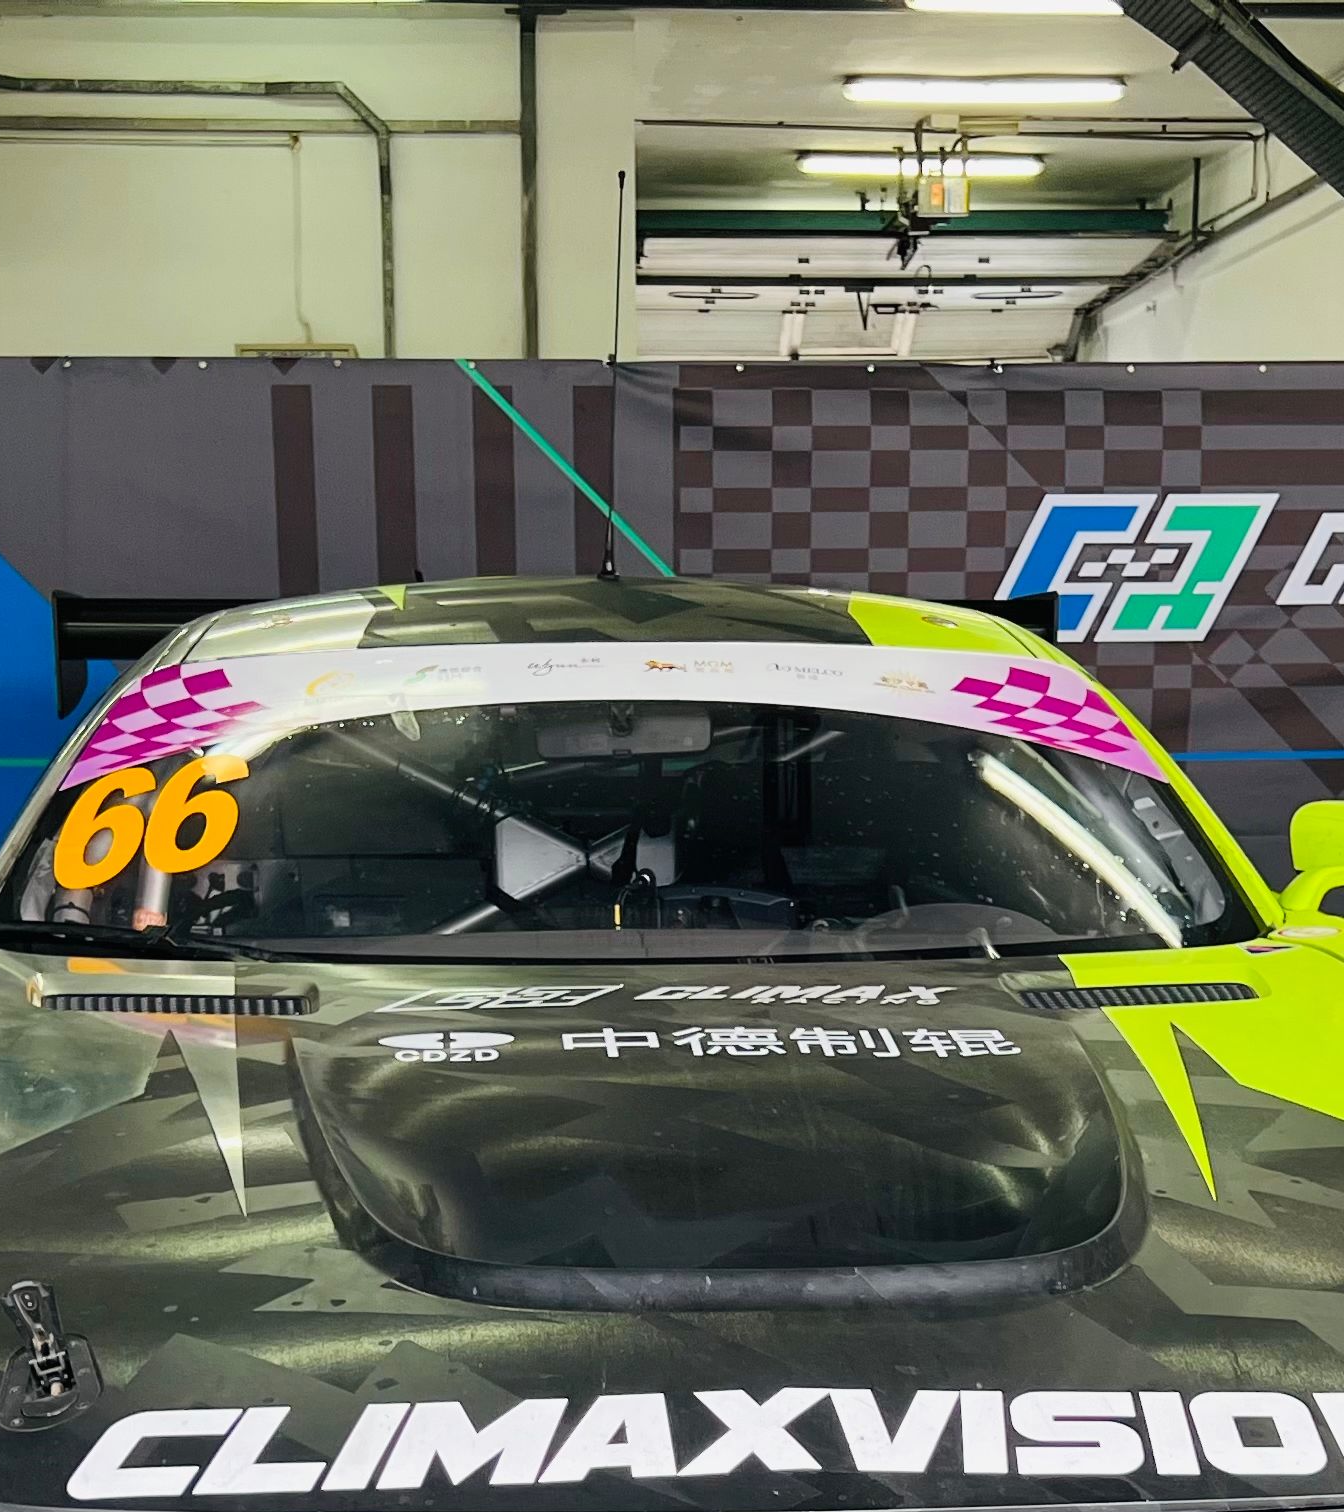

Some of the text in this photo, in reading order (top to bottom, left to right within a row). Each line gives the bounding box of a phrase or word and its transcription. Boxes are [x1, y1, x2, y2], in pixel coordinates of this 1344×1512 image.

[53, 754, 250, 890] 66
[632, 984, 958, 1000] CLIMAX
[561, 1025, 1022, 1060] 中德制辊
[394, 1049, 500, 1063] CDZD
